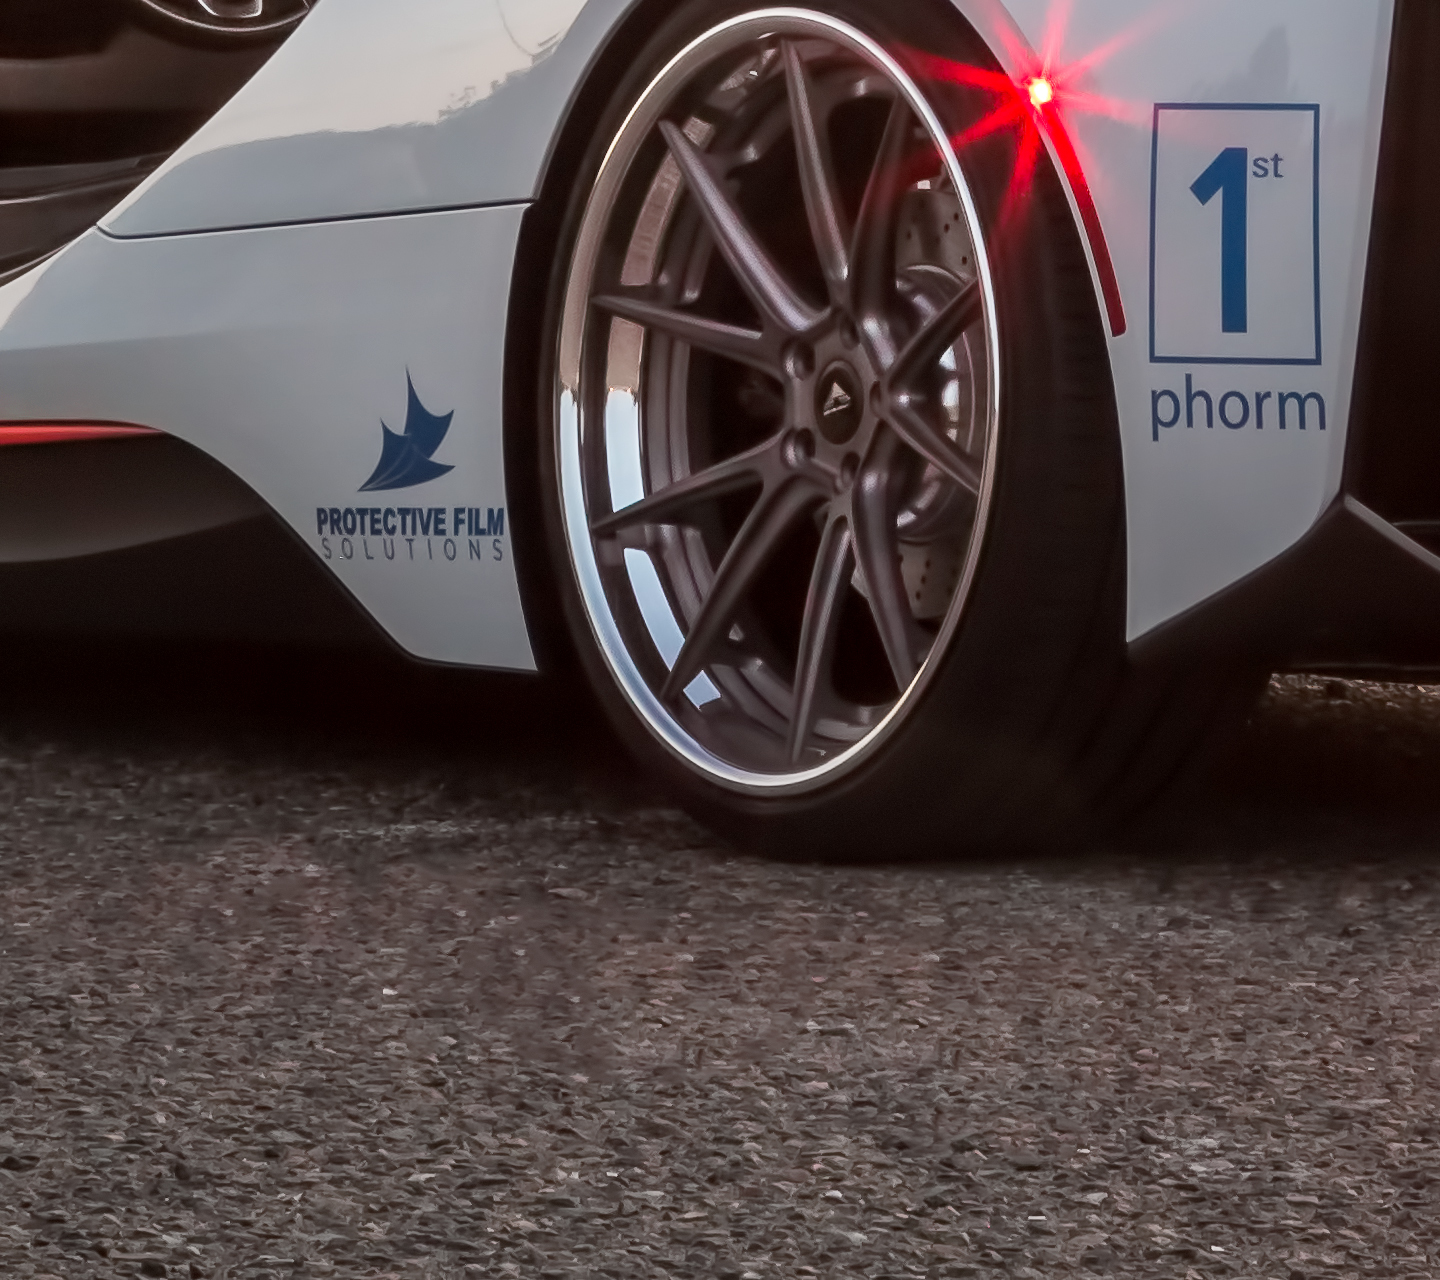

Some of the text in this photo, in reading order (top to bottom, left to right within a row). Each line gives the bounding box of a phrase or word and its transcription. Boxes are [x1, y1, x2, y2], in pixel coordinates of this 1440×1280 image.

[1151, 373, 1327, 442] phorm
[316, 507, 504, 536] PROTECTIVE FILM
[321, 538, 503, 560] SOLUTIONS
